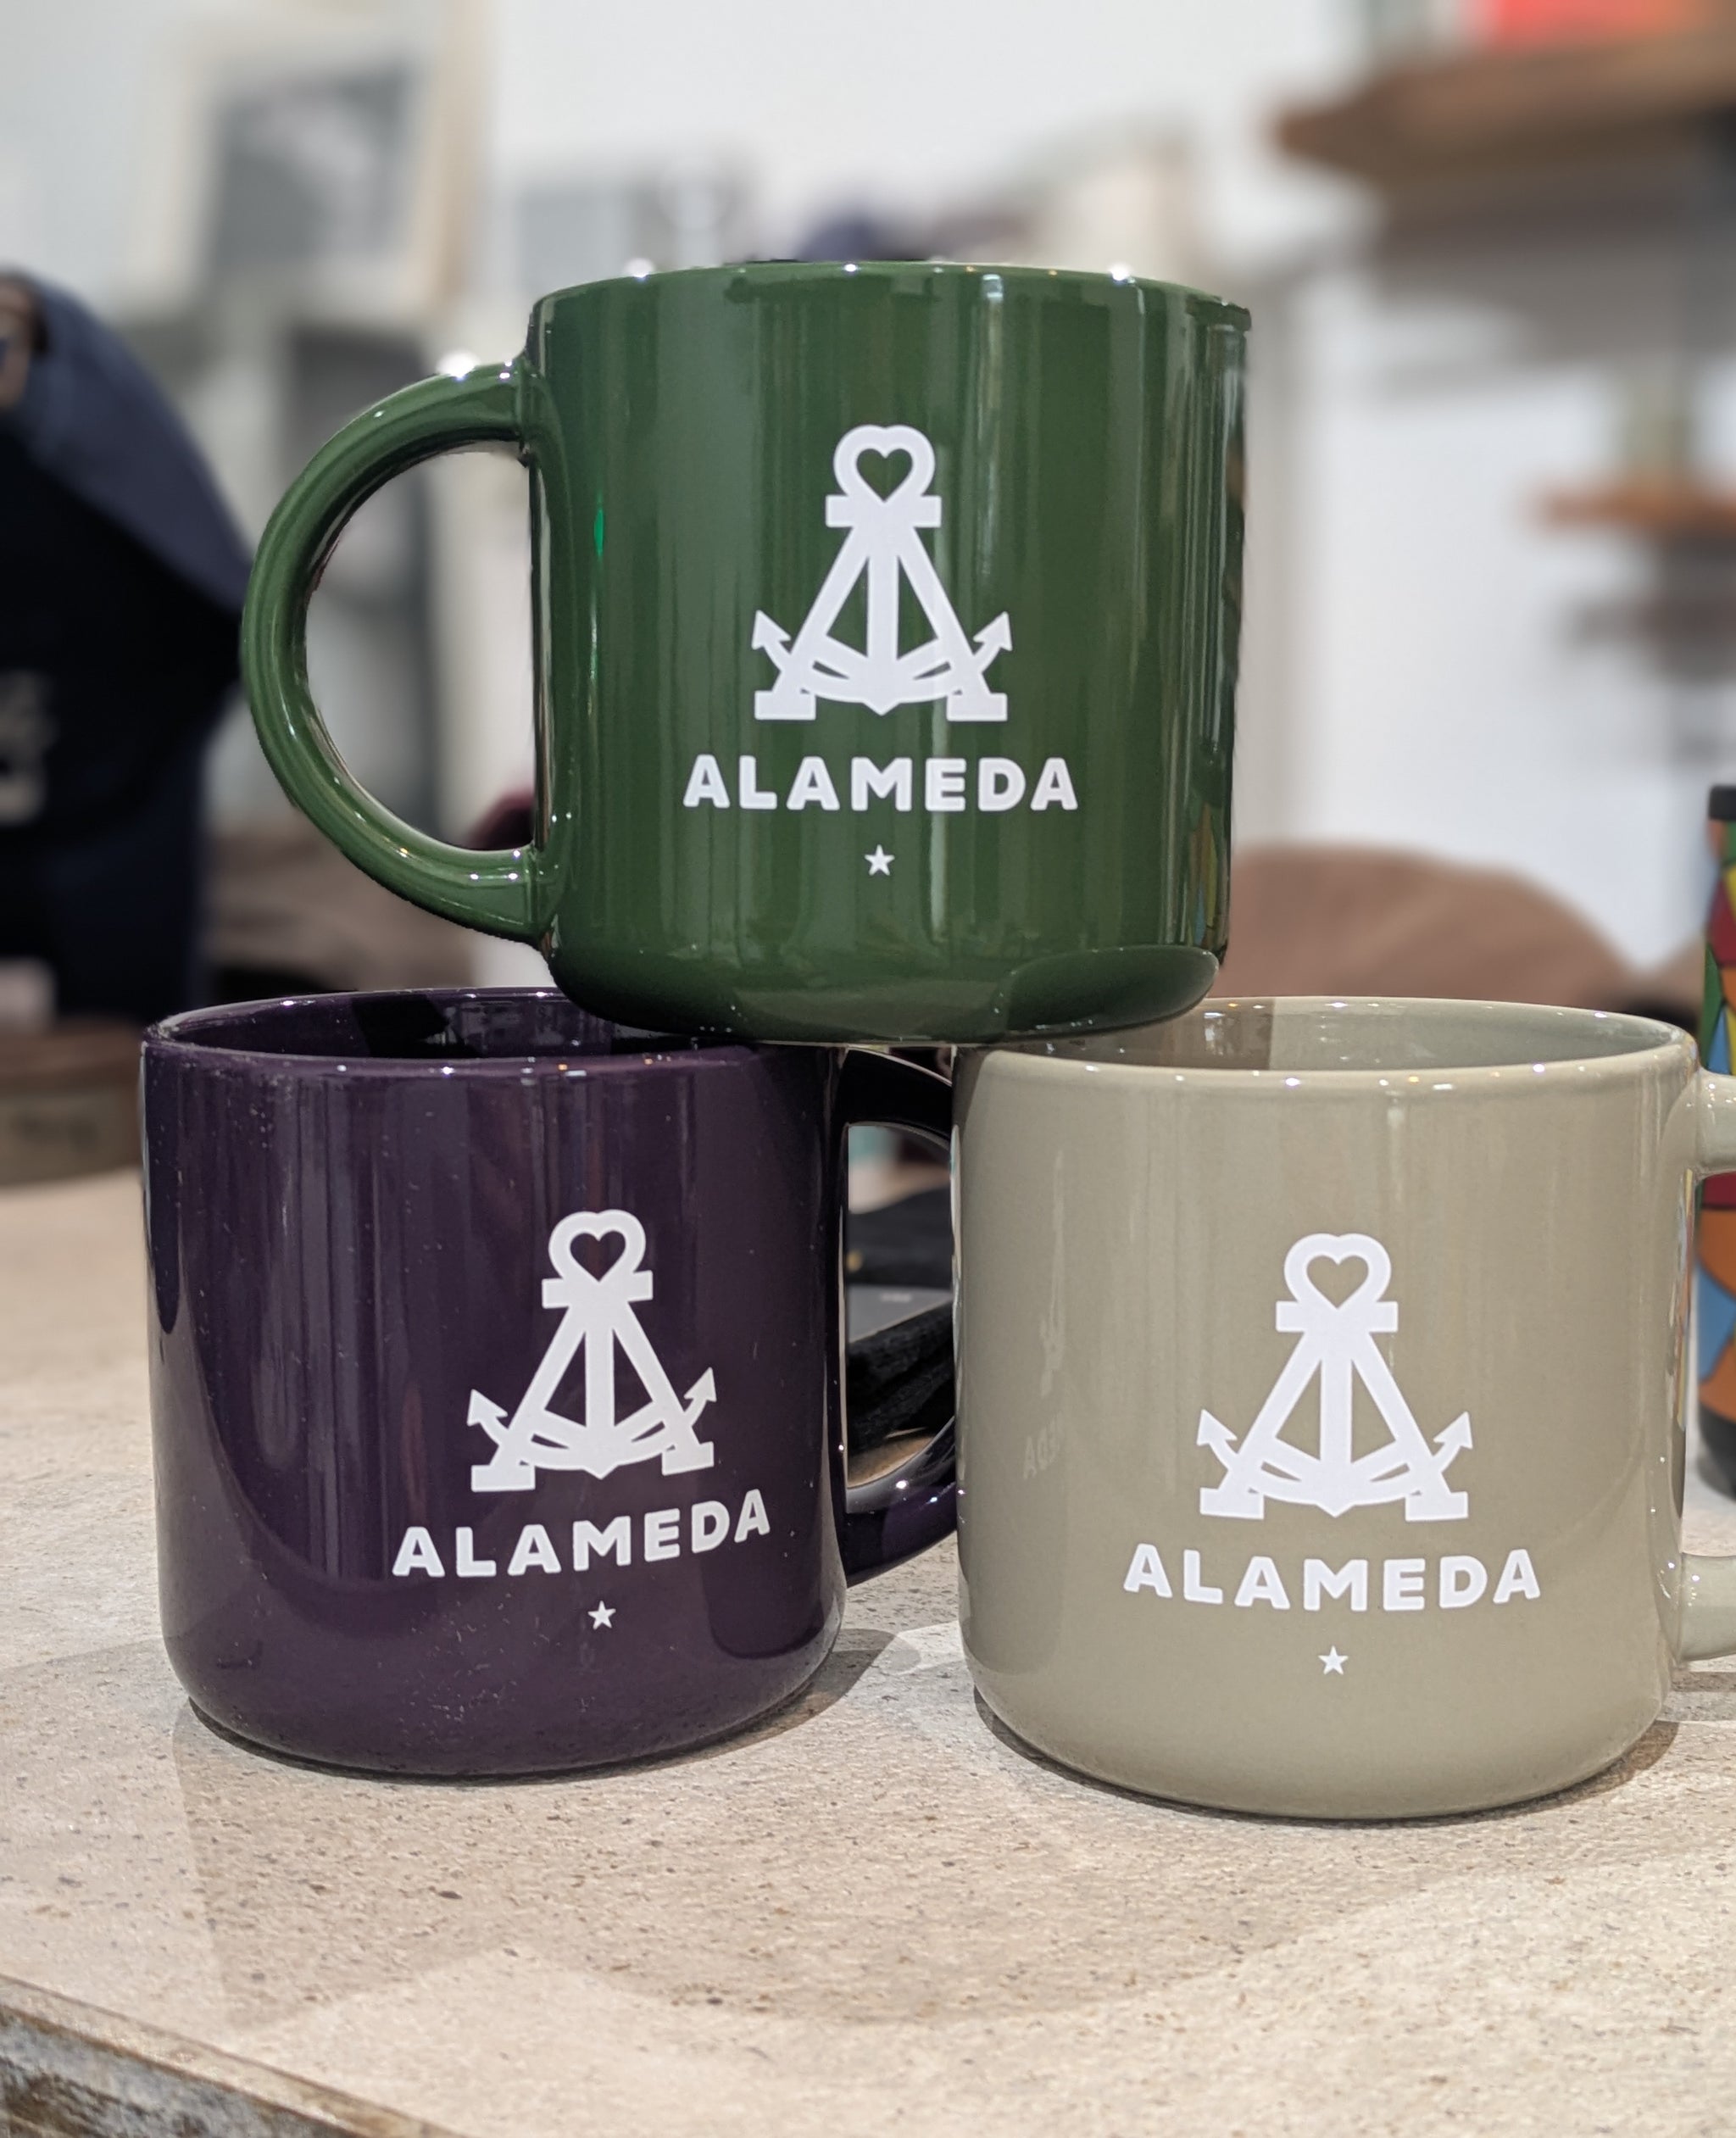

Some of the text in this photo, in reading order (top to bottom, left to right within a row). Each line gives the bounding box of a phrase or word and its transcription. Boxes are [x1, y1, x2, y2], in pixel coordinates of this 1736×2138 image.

[683, 754, 1078, 811] ALAMEDA
[392, 1489, 771, 1578] ALAMEDA
[1122, 1543, 1541, 1612] ALAMEDA
